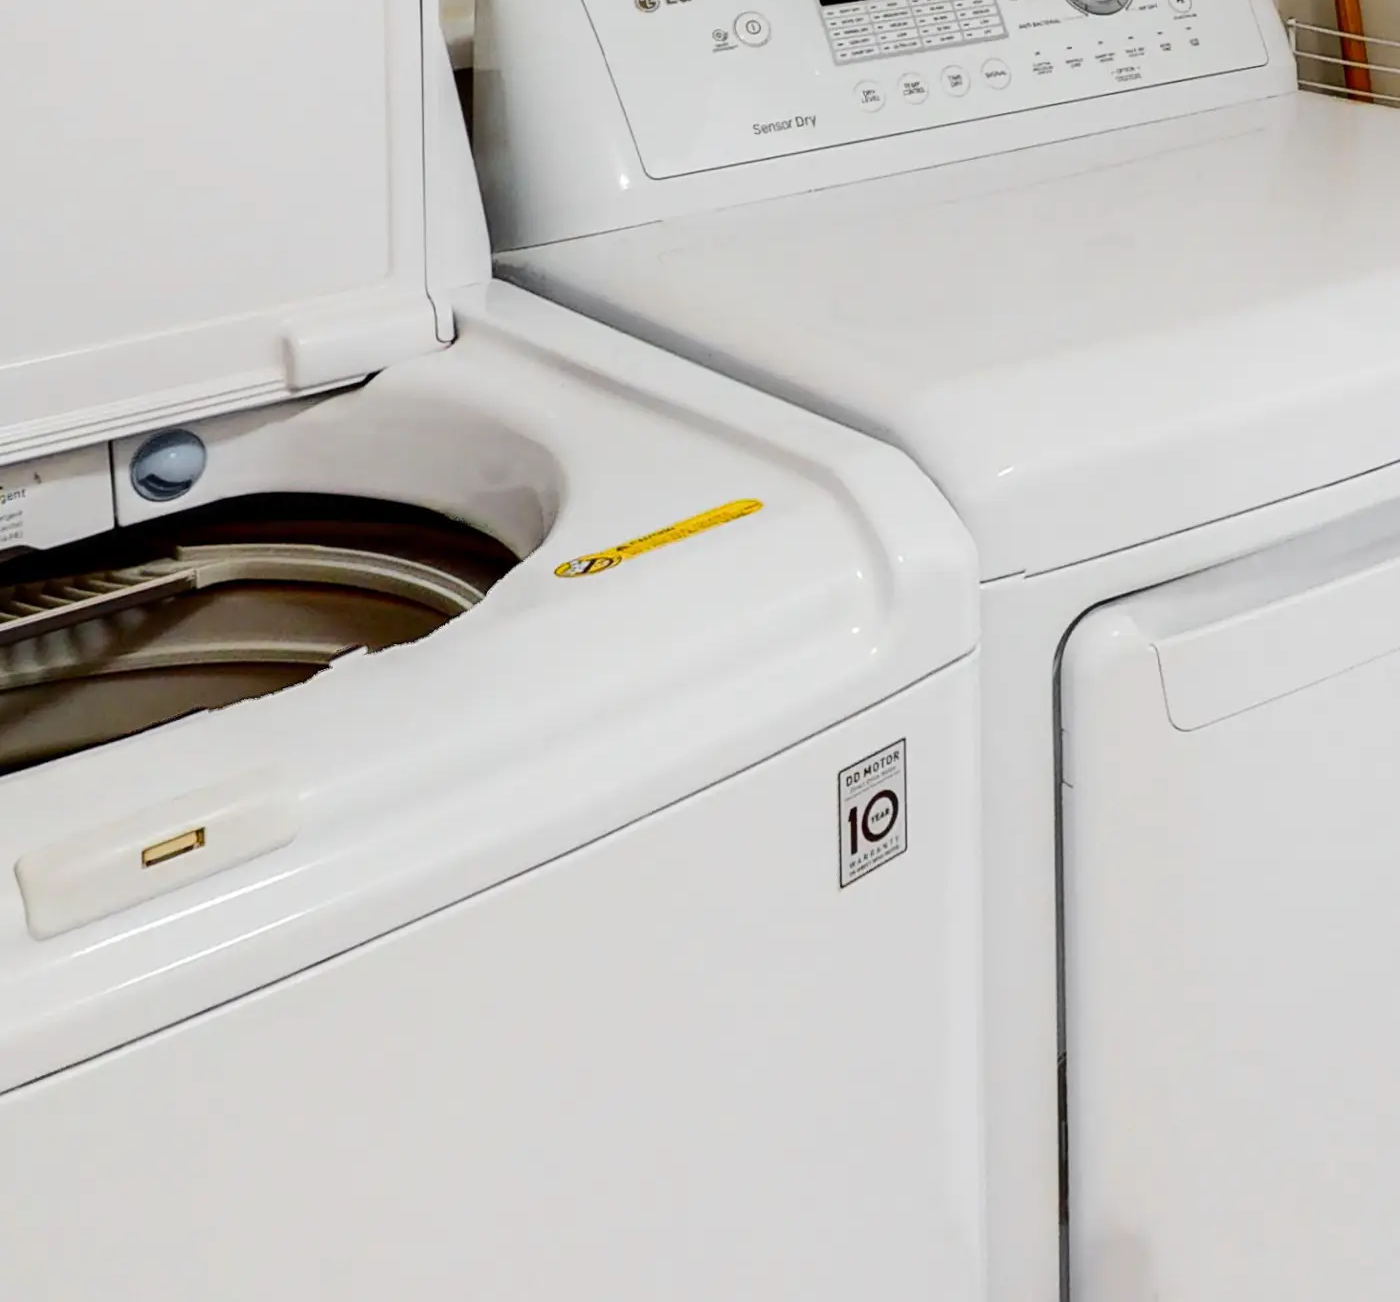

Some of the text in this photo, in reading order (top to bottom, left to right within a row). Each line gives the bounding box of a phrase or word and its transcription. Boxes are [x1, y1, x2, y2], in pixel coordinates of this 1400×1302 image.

[752, 114, 817, 136] Sensor Dry
[845, 771, 861, 787] DD
[863, 749, 900, 778] MOTOR
[848, 789, 899, 856] 10
[870, 807, 890, 825] YEAR
